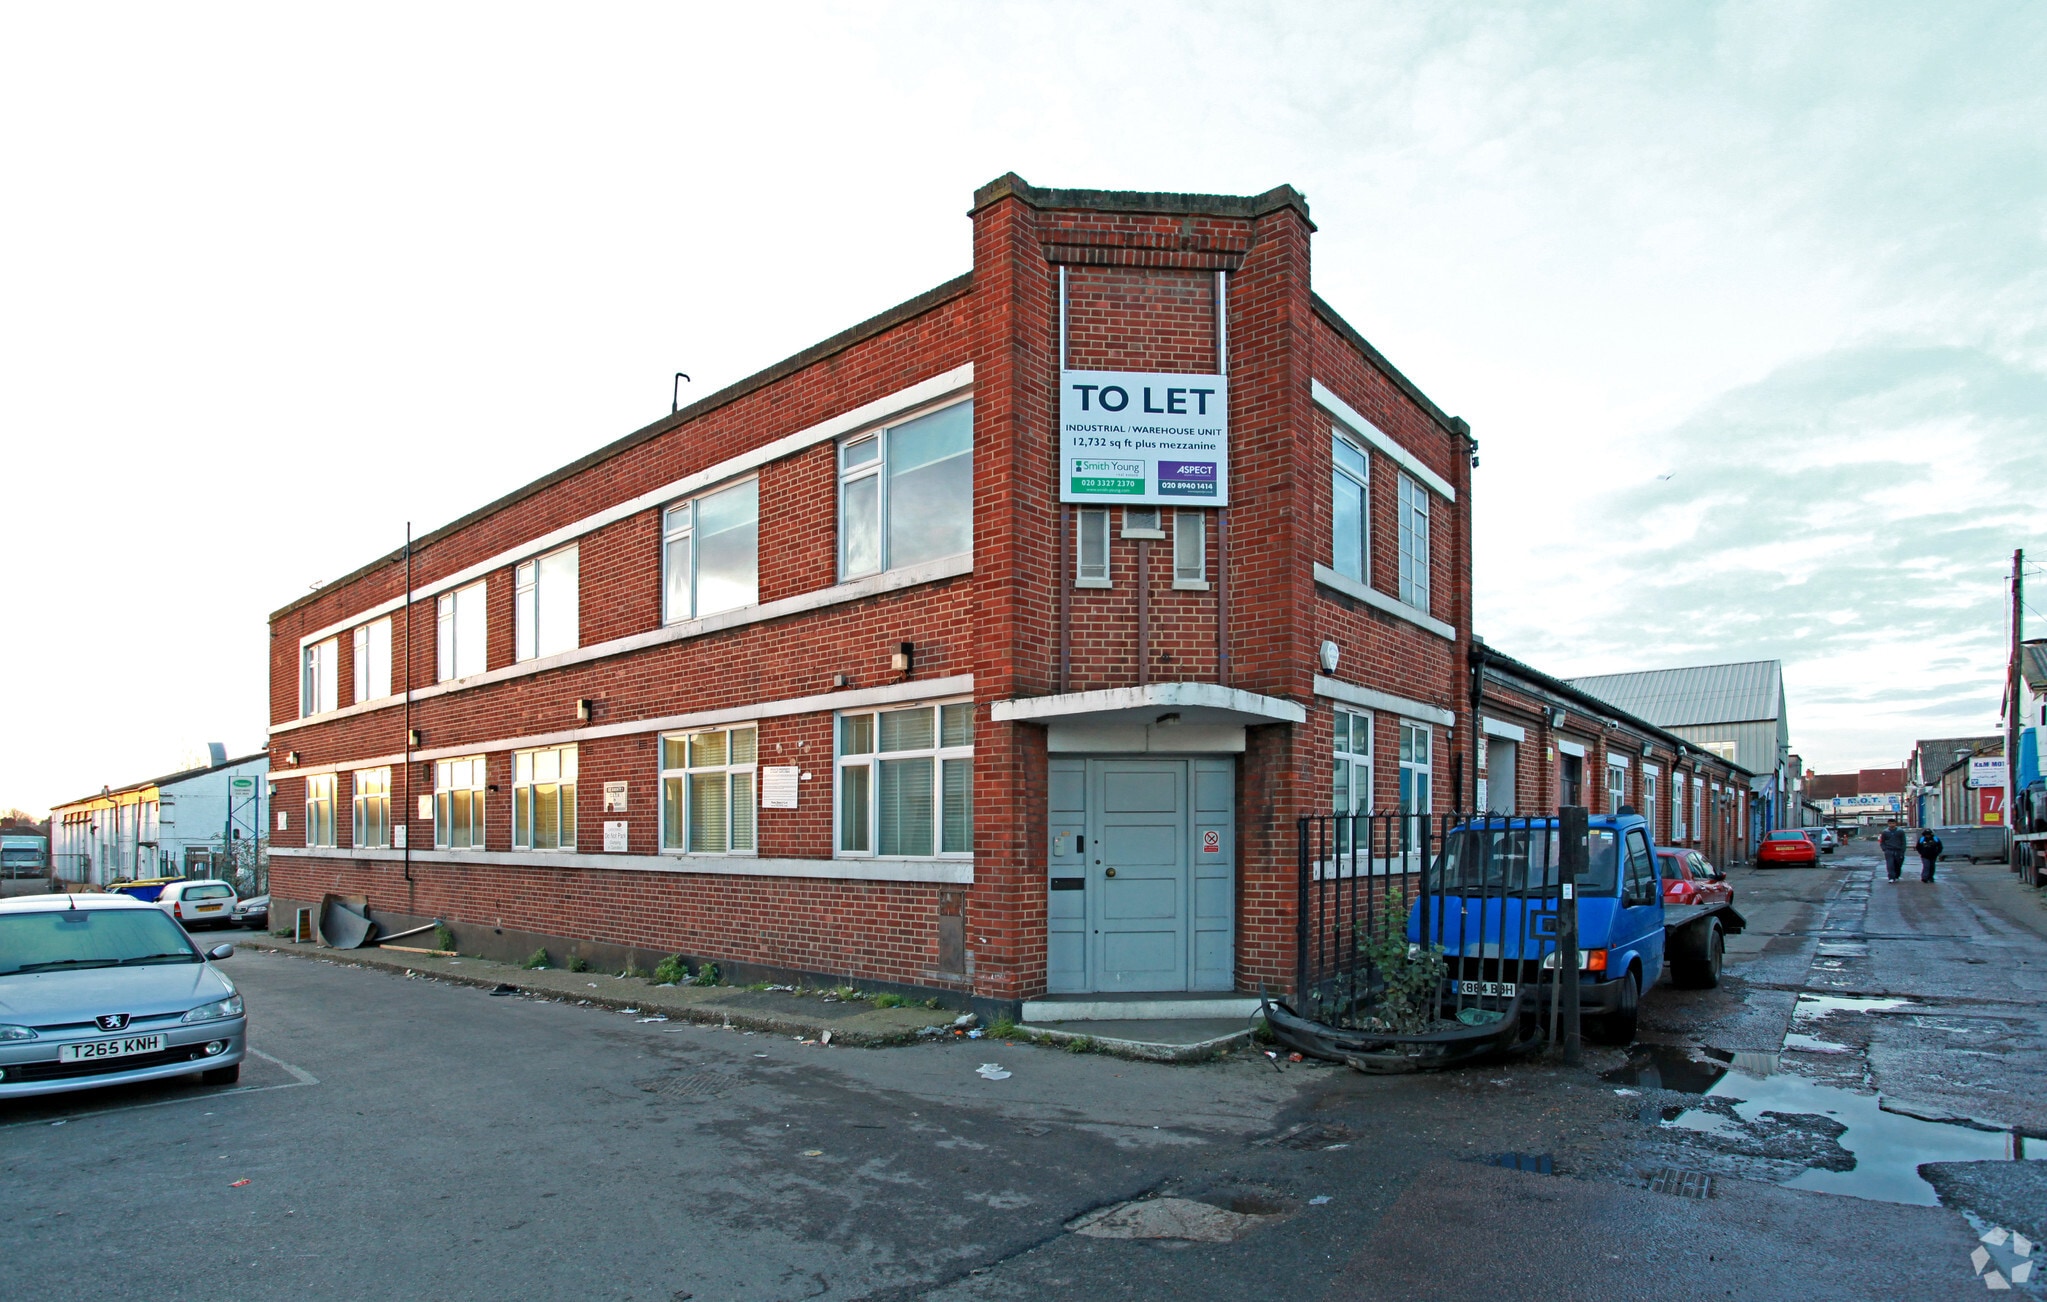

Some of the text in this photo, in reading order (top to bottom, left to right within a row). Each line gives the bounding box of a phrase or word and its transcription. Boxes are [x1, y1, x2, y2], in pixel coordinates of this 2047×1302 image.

[1072, 384, 1215, 415] TO LET
[1065, 424, 1126, 433] INDUSTRIAL
[1197, 428, 1222, 436] UNIT
[1073, 437, 1216, 450] 12,732 sq ft plus mezzanine
[1084, 461, 1140, 473] Smith Young
[1176, 466, 1213, 474] ASPECT
[72, 1036, 158, 1058] T265 KNH
